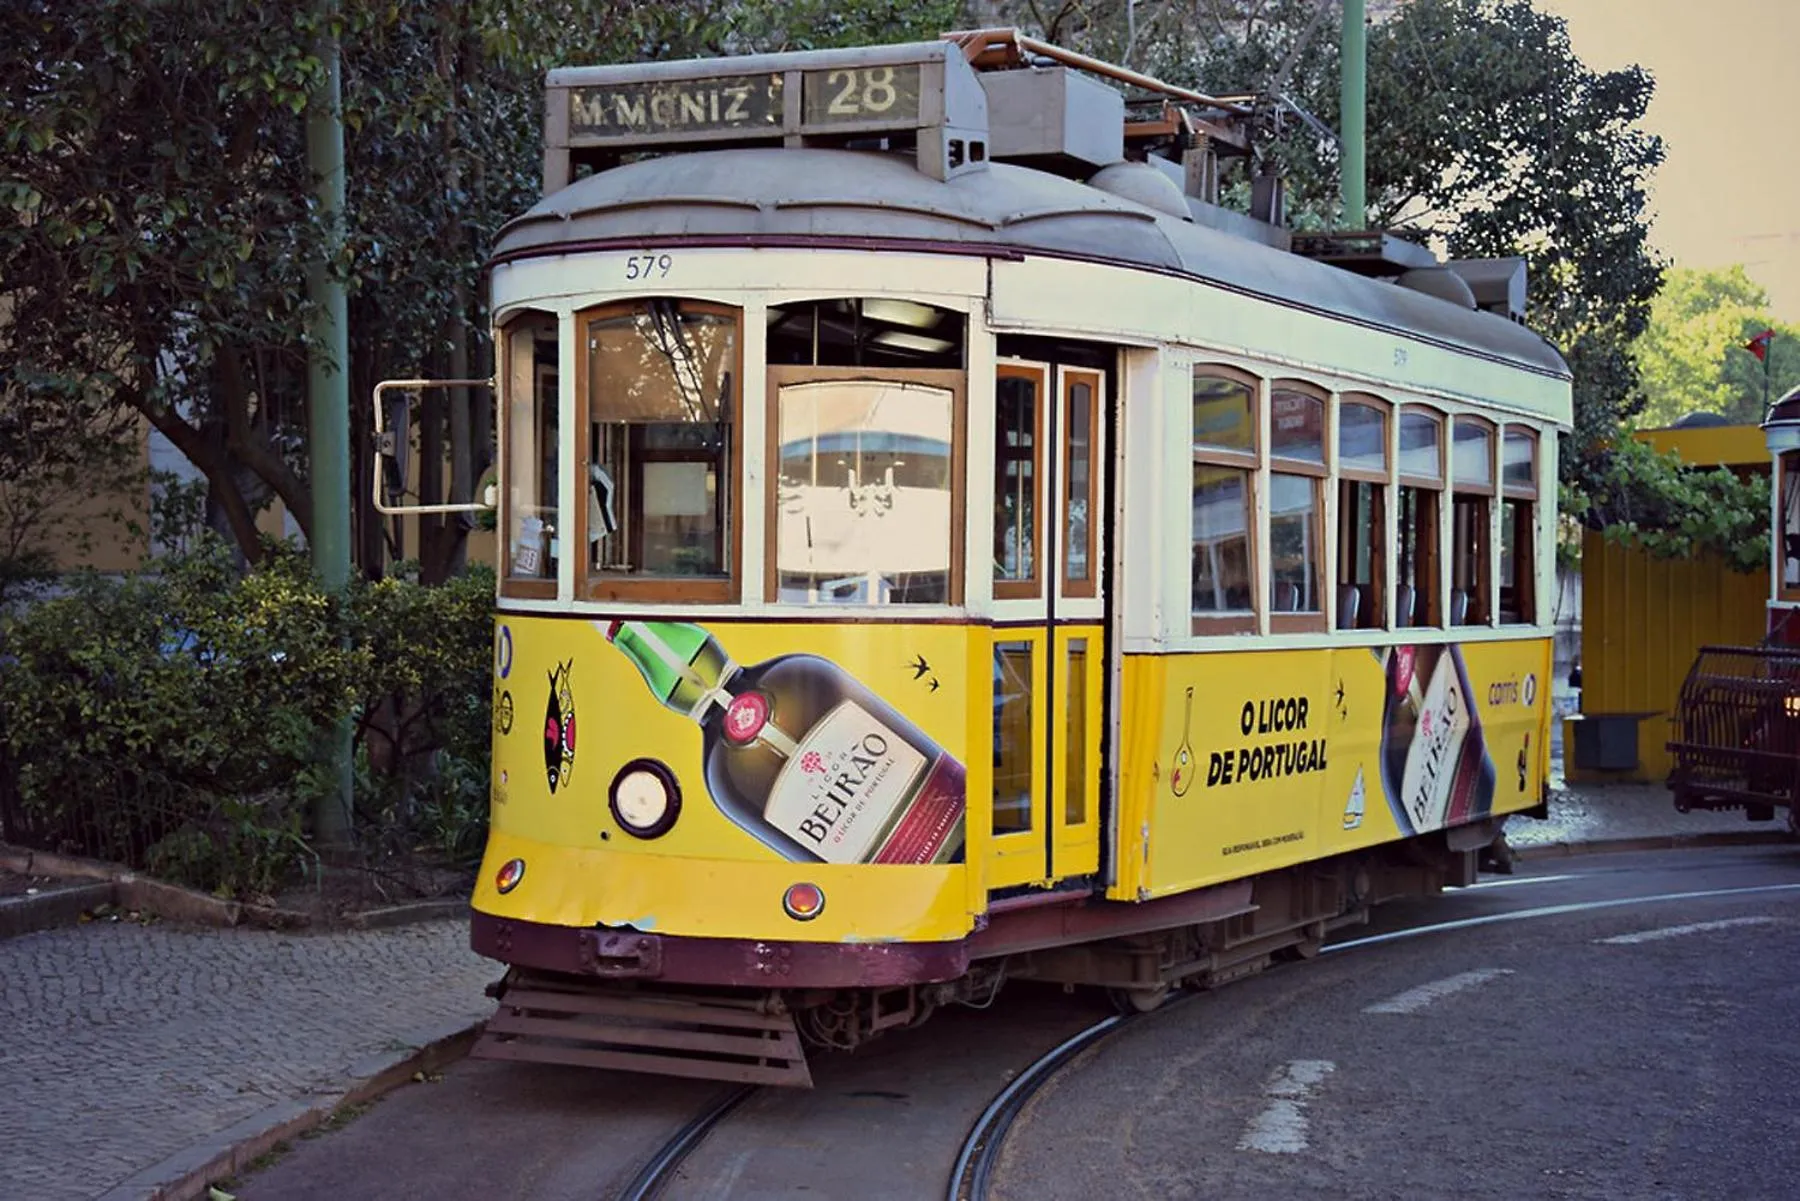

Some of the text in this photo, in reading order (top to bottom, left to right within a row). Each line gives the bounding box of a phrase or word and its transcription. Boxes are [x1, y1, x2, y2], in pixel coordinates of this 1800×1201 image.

[827, 67, 897, 114] 28
[626, 254, 673, 279] 579
[1241, 696, 1309, 736] O LICOR
[811, 751, 848, 800] LICOR
[1207, 738, 1328, 788] DE PORTUGAL
[799, 733, 888, 844] BEIRÃO
